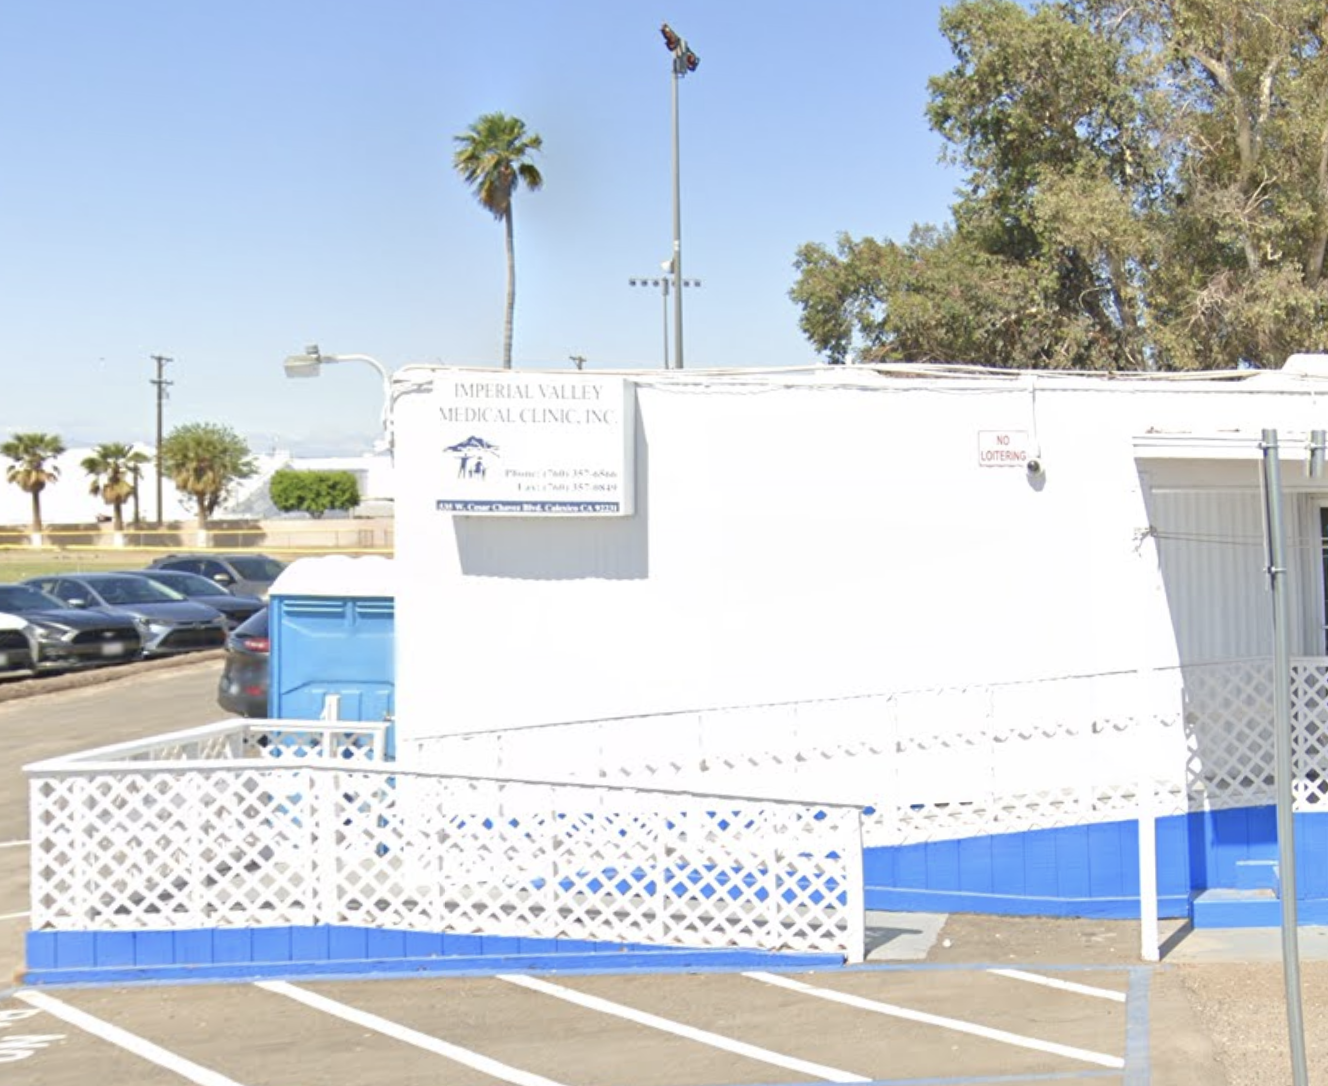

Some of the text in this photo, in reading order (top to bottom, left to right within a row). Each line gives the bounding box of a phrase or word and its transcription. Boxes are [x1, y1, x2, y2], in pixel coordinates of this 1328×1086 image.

[455, 382, 603, 400] IMPERIAL VALLEY
[439, 406, 618, 425] MEDICAL CLINIC, INC.
[996, 435, 1010, 446] NO
[981, 450, 1027, 461] LOITERING
